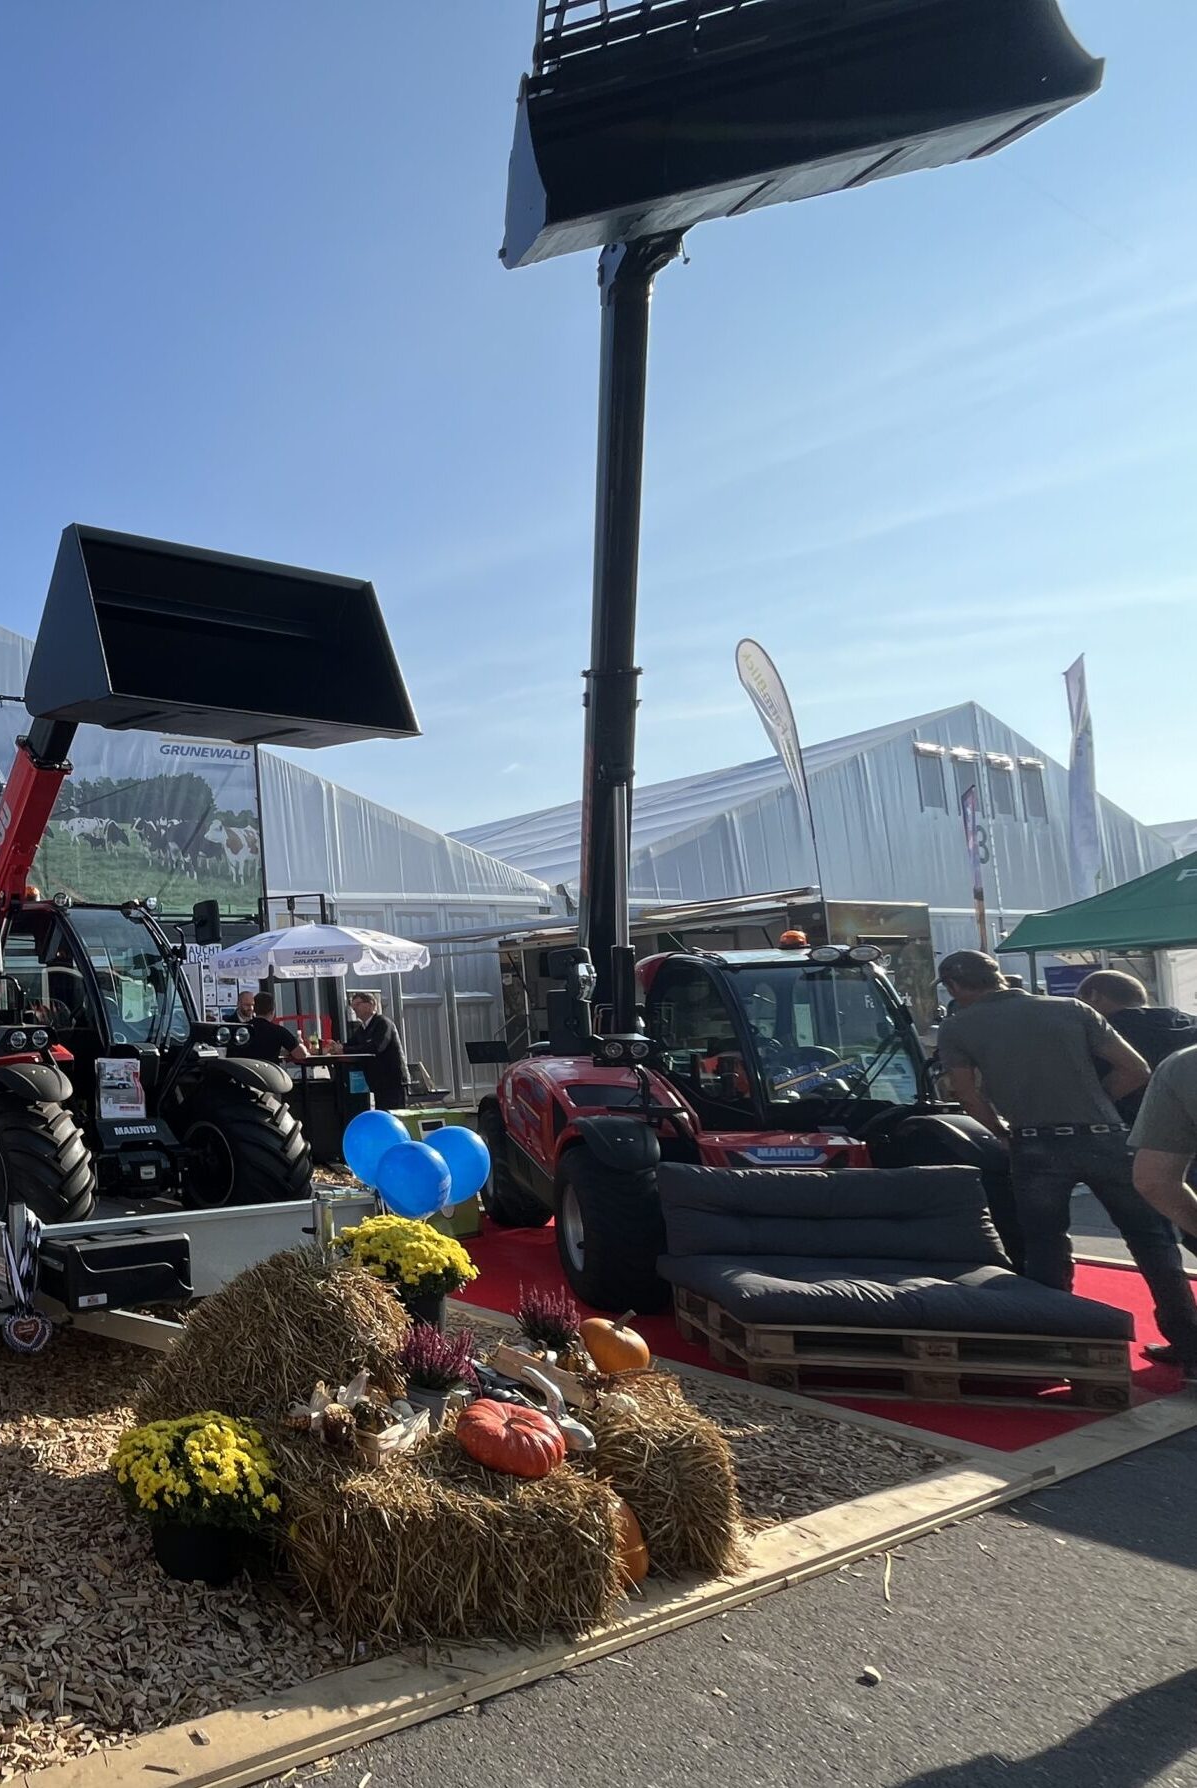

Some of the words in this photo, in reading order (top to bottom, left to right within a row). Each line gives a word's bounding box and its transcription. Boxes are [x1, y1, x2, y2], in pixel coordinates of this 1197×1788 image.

[159, 744, 251, 760] GRUNEWALD
[975, 825, 990, 864] 3
[292, 957, 345, 965] GRUNEWALD
[114, 1125, 157, 1136] MANITOU
[757, 1147, 815, 1157] MANITOU
